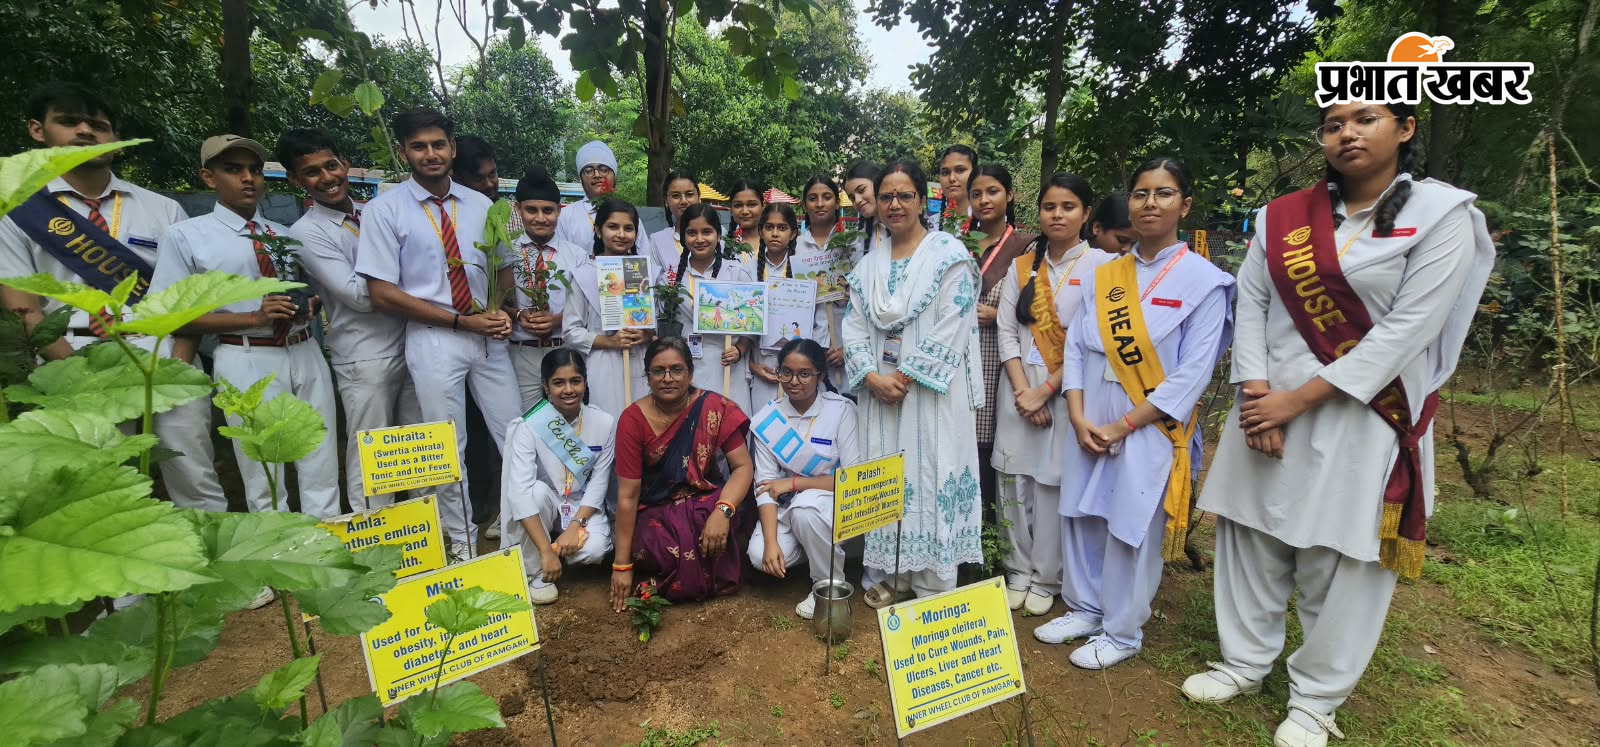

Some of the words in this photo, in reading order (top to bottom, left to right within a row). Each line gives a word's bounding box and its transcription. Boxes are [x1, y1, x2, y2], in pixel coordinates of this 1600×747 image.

[1282, 244, 1348, 333] HOUSE
[1107, 305, 1144, 366] HEAD
[374, 446, 409, 459] (Swertia
[412, 441, 444, 453] chirata)
[383, 431, 426, 445] Chiraita
[370, 471, 393, 481] Tonic
[396, 468, 412, 477] and
[414, 466, 426, 474] for
[428, 463, 452, 472] Fever.
[377, 459, 398, 469] Used
[421, 453, 444, 463] Bitter
[857, 466, 881, 481] Palash
[840, 500, 854, 512] Used
[856, 498, 862, 506] To
[880, 487, 900, 499] Wounds
[347, 516, 387, 533] Amla:
[841, 512, 853, 523] And
[344, 534, 380, 550] nthus
[384, 520, 431, 541] emlica)
[405, 537, 428, 552] and
[399, 556, 422, 570] lth.
[426, 577, 464, 598] Mint:
[921, 602, 971, 625] Moringa:
[372, 631, 401, 650] Used
[405, 625, 420, 638] for
[458, 638, 478, 651] and
[481, 625, 509, 643] heart
[911, 628, 950, 650] (Moringa
[952, 616, 987, 636] oleifera)
[449, 660, 472, 673] CLUB
[473, 654, 485, 664] OF
[487, 638, 529, 659] RAMGARH
[893, 654, 915, 671] Used
[917, 652, 926, 662] to
[928, 646, 949, 659] Cure
[949, 634, 986, 652] Wounds,
[906, 666, 937, 684] Ulcers,
[938, 659, 959, 673] Liver
[961, 652, 977, 665] and
[979, 643, 1002, 660] Heart
[911, 678, 953, 700] Diseases,
[954, 667, 984, 685] Cancer
[986, 661, 1002, 675] etc.
[928, 701, 952, 715] WHEEL
[953, 694, 971, 707] CLUB
[972, 690, 981, 700] OF
[981, 678, 1015, 696] RAMGARH
